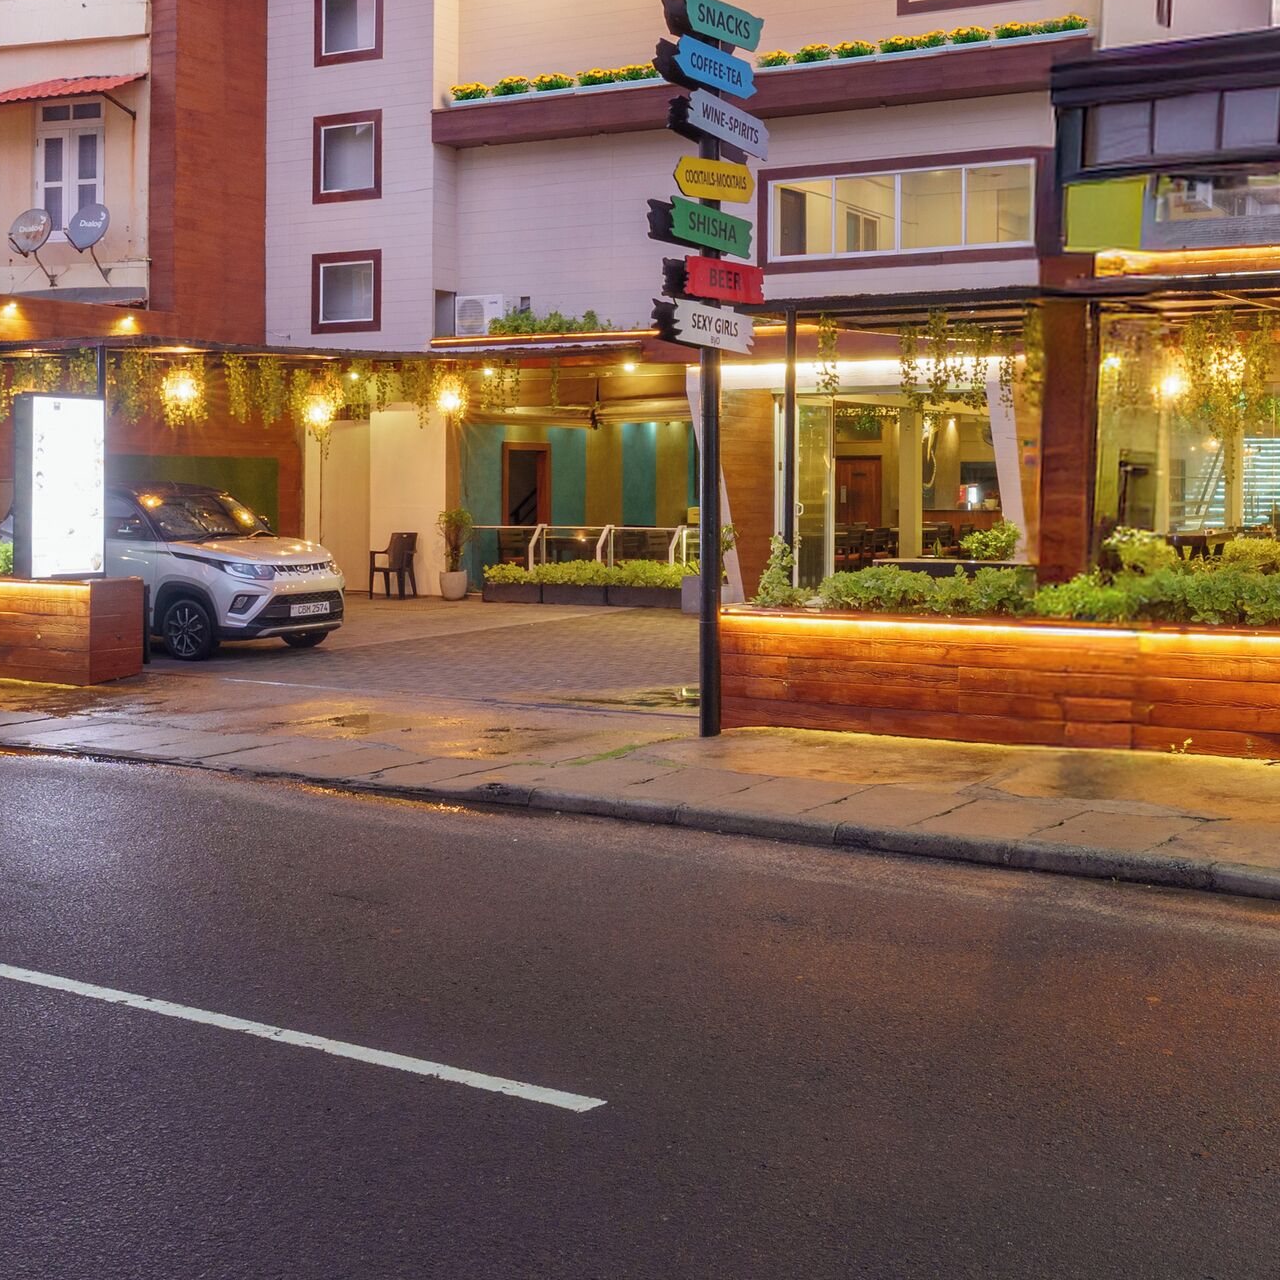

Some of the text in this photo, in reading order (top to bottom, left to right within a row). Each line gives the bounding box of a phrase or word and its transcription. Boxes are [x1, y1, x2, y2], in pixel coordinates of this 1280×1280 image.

[697, 3, 750, 40] SNACKS
[690, 52, 742, 88] COFFEE-TEA
[702, 102, 759, 145] WINE-SPIRITS
[685, 169, 747, 190] COCKTAILS-MOCKTAILS
[688, 211, 737, 244] SHISHA
[709, 268, 741, 291] BEER
[691, 312, 739, 337] SEXY GIRLS
